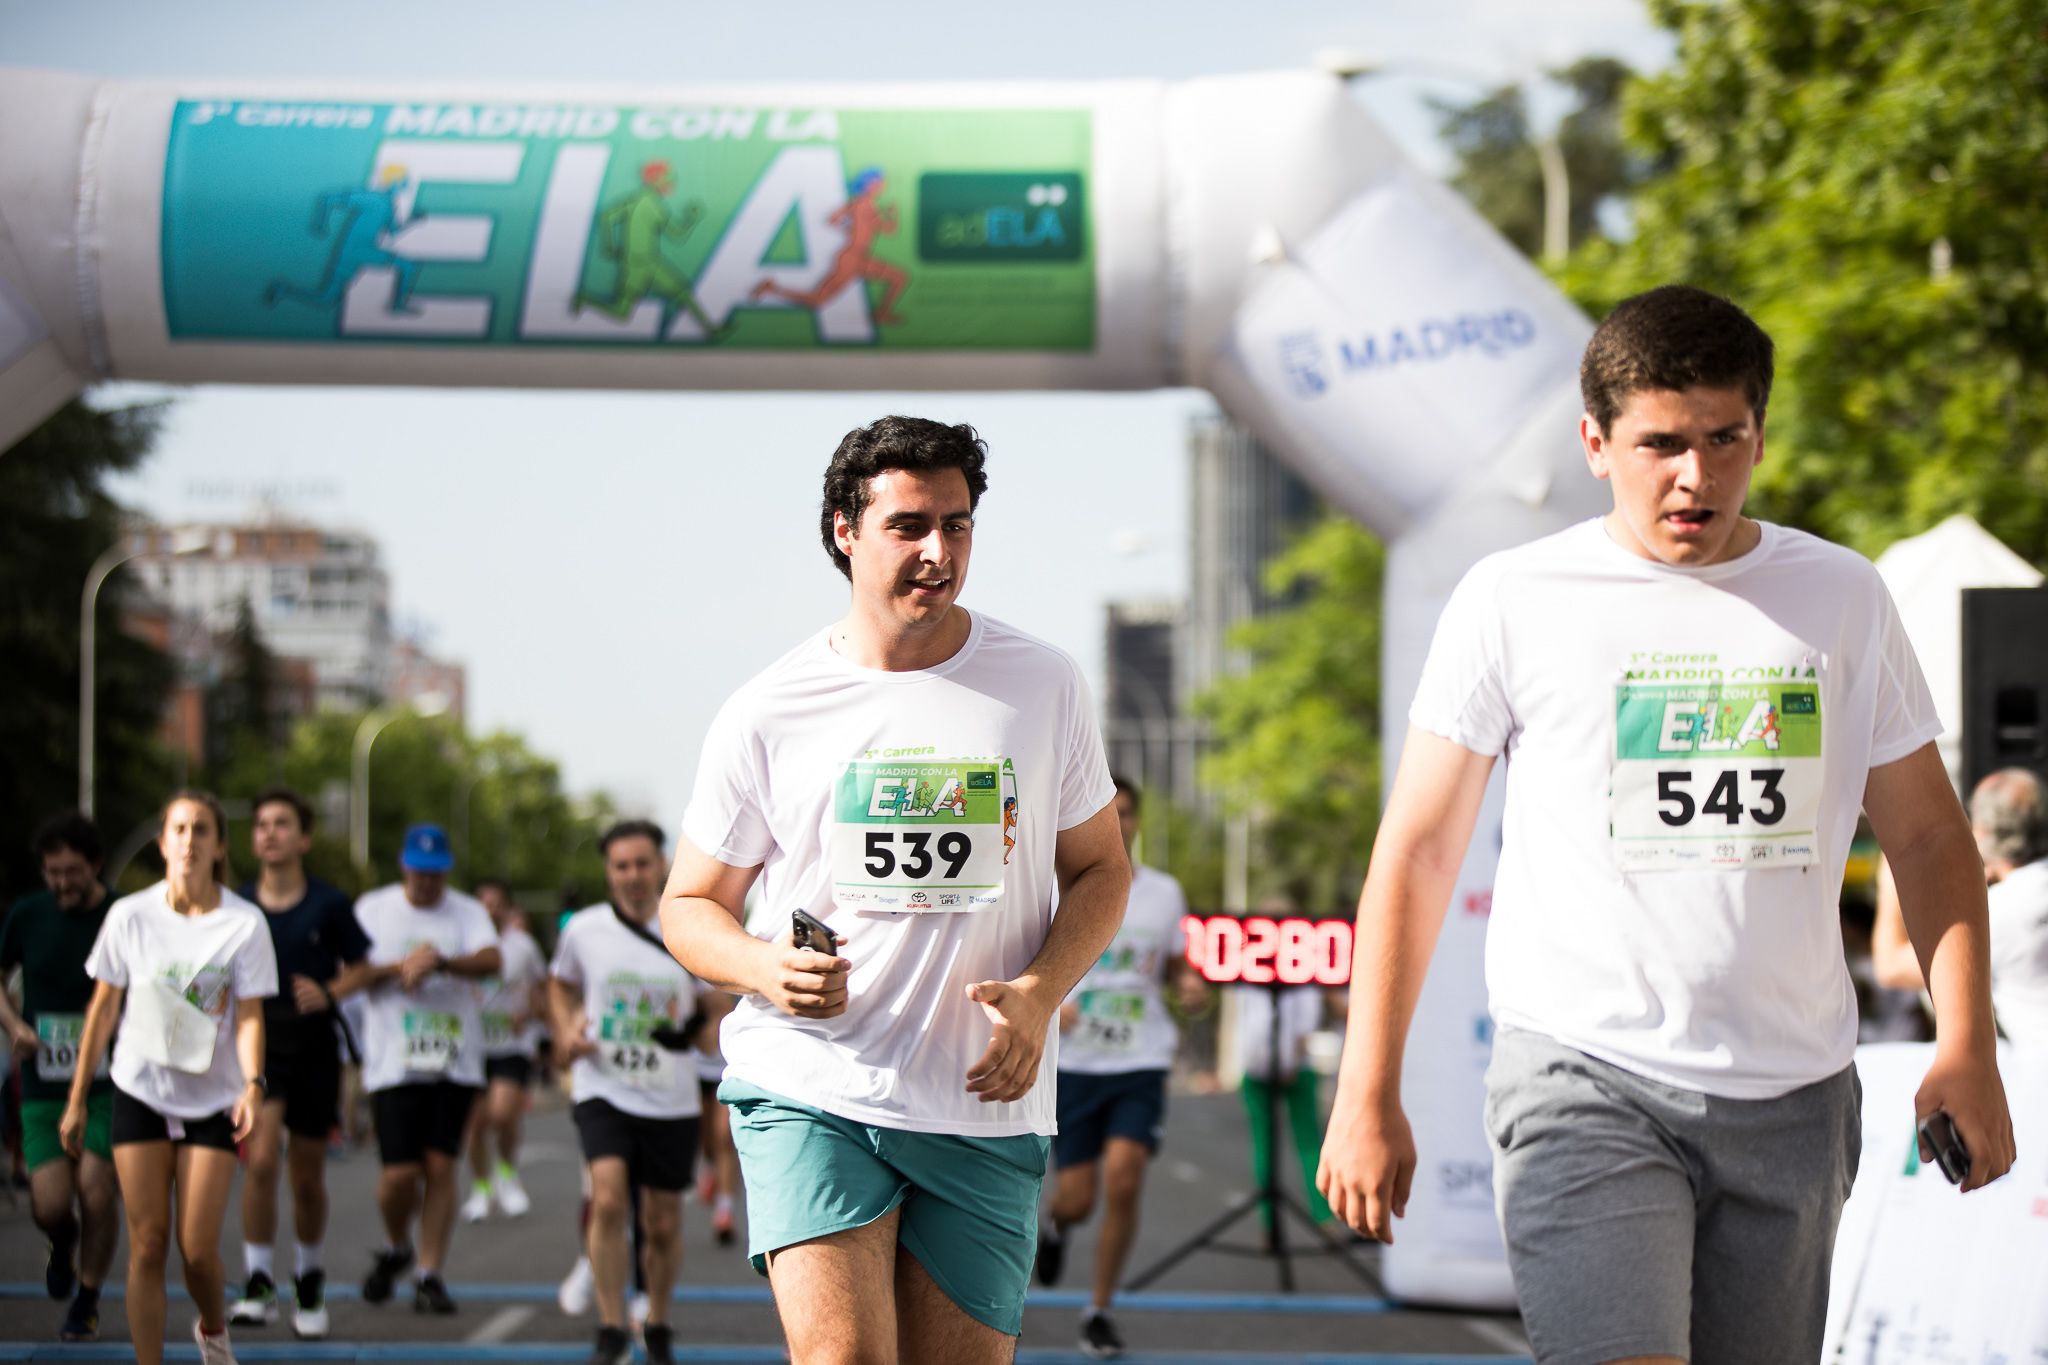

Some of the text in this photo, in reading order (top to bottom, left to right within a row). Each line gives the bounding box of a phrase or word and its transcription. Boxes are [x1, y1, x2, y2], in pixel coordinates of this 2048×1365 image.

[235, 105, 373, 129] Carrera
[384, 104, 619, 138] MADRID
[630, 108, 758, 140] CON
[767, 110, 839, 141] LA
[341, 141, 877, 342] ELA
[1338, 309, 1535, 374] MADRID
[1651, 652, 1718, 664] Carrera
[1657, 700, 1780, 752] ELA
[875, 767, 919, 777] MADRID
[920, 767, 943, 776] CON
[944, 767, 958, 777] LA
[882, 746, 936, 759] Carrera
[867, 777, 966, 817] ELA
[1657, 769, 1787, 826] 543
[864, 831, 972, 879] 539
